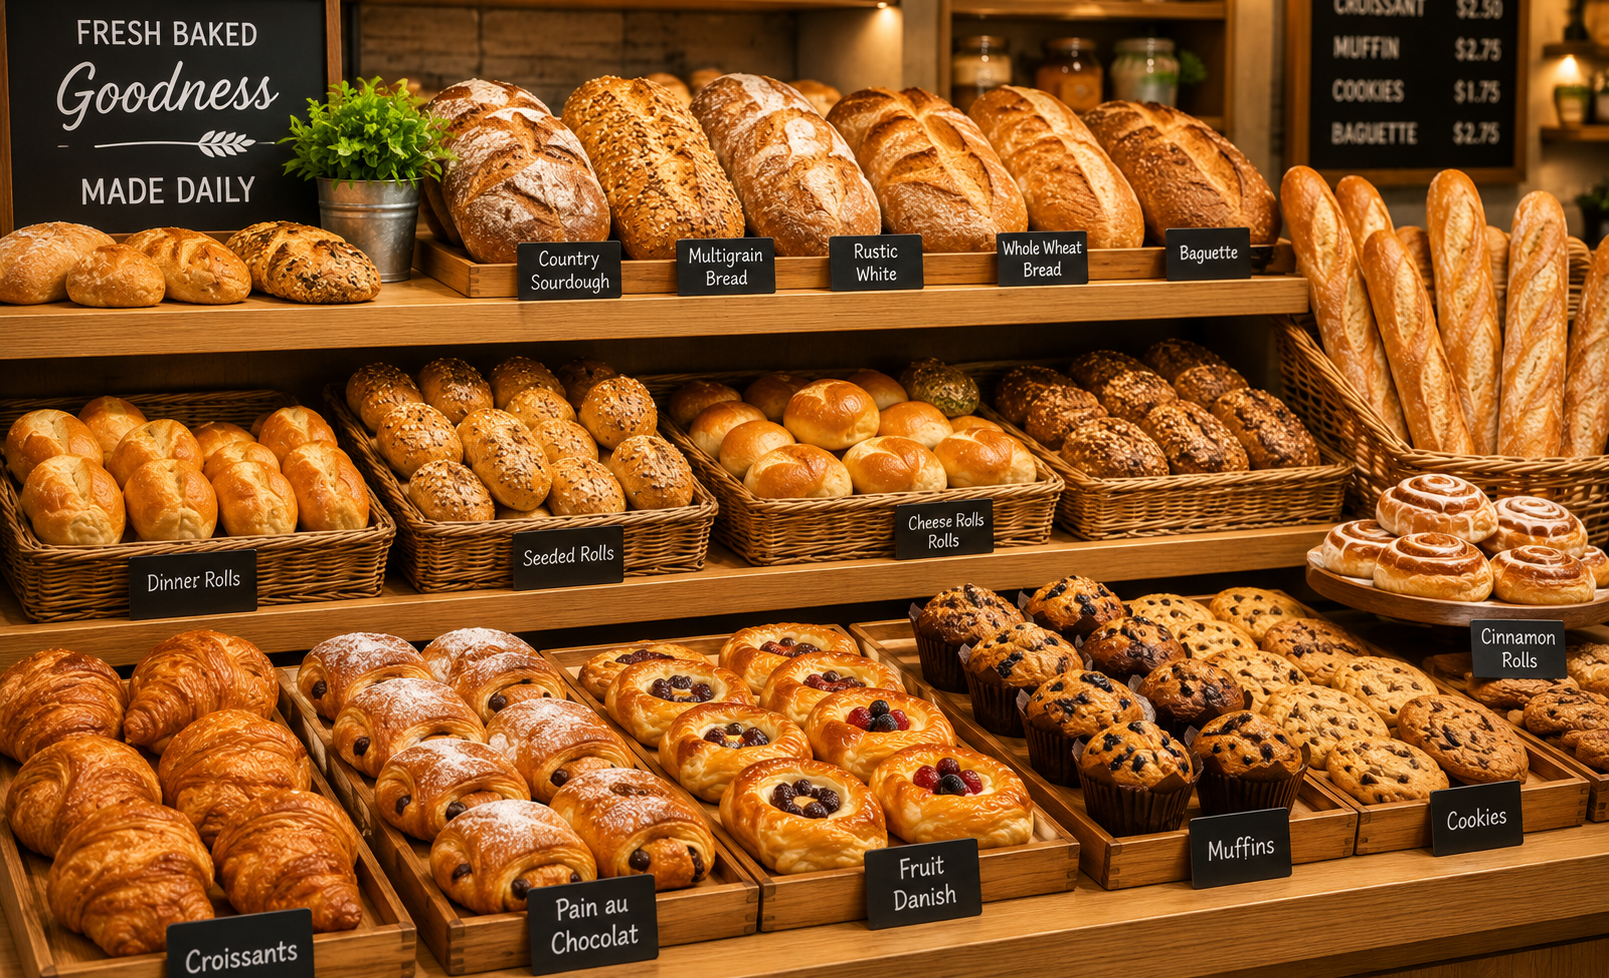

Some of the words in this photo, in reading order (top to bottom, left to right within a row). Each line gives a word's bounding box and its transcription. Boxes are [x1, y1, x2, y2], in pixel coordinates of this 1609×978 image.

[1333, 0, 1425, 17] CROISSANT
[77, 19, 161, 46] FRESH
[173, 20, 258, 47] BAKED
[1333, 35, 1400, 59] MUFFIN
[1454, 37, 1502, 62] $2.75
[56, 60, 280, 132] Goodness
[1331, 78, 1405, 103] COOKIES
[1454, 79, 1501, 104] $1.75
[1331, 121, 1417, 145] BAGUETTE
[1452, 121, 1500, 145] $2.75
[81, 177, 165, 205] MADE
[176, 175, 256, 204] DAILY
[688, 246, 763, 267] Multigrain
[854, 242, 898, 259] Rustic
[1002, 239, 1040, 256] Whole
[1042, 239, 1082, 255] Wheat
[1179, 244, 1238, 265] Baguette
[538, 250, 600, 271] Country
[1023, 260, 1062, 278] Bread
[531, 272, 610, 295] Sourdough
[706, 269, 748, 286] Bread
[856, 265, 897, 282] White
[908, 513, 953, 531] Cheese
[956, 511, 985, 528] Rolls
[928, 532, 960, 549] Rolls
[523, 546, 576, 567] Seeded
[580, 543, 615, 562] Rolls
[147, 573, 201, 592] Dinner
[205, 568, 241, 588] Rolls
[1481, 627, 1556, 646] Cinnamon
[1501, 651, 1538, 669] Rolls
[1447, 807, 1507, 831] Cookies
[1208, 835, 1275, 862] Muffins
[899, 855, 945, 880] Fruit
[555, 897, 598, 922] Pain
[605, 898, 629, 915] au
[893, 883, 957, 912] Danish
[551, 923, 639, 955] Chocolat
[185, 940, 298, 974] Croissants
